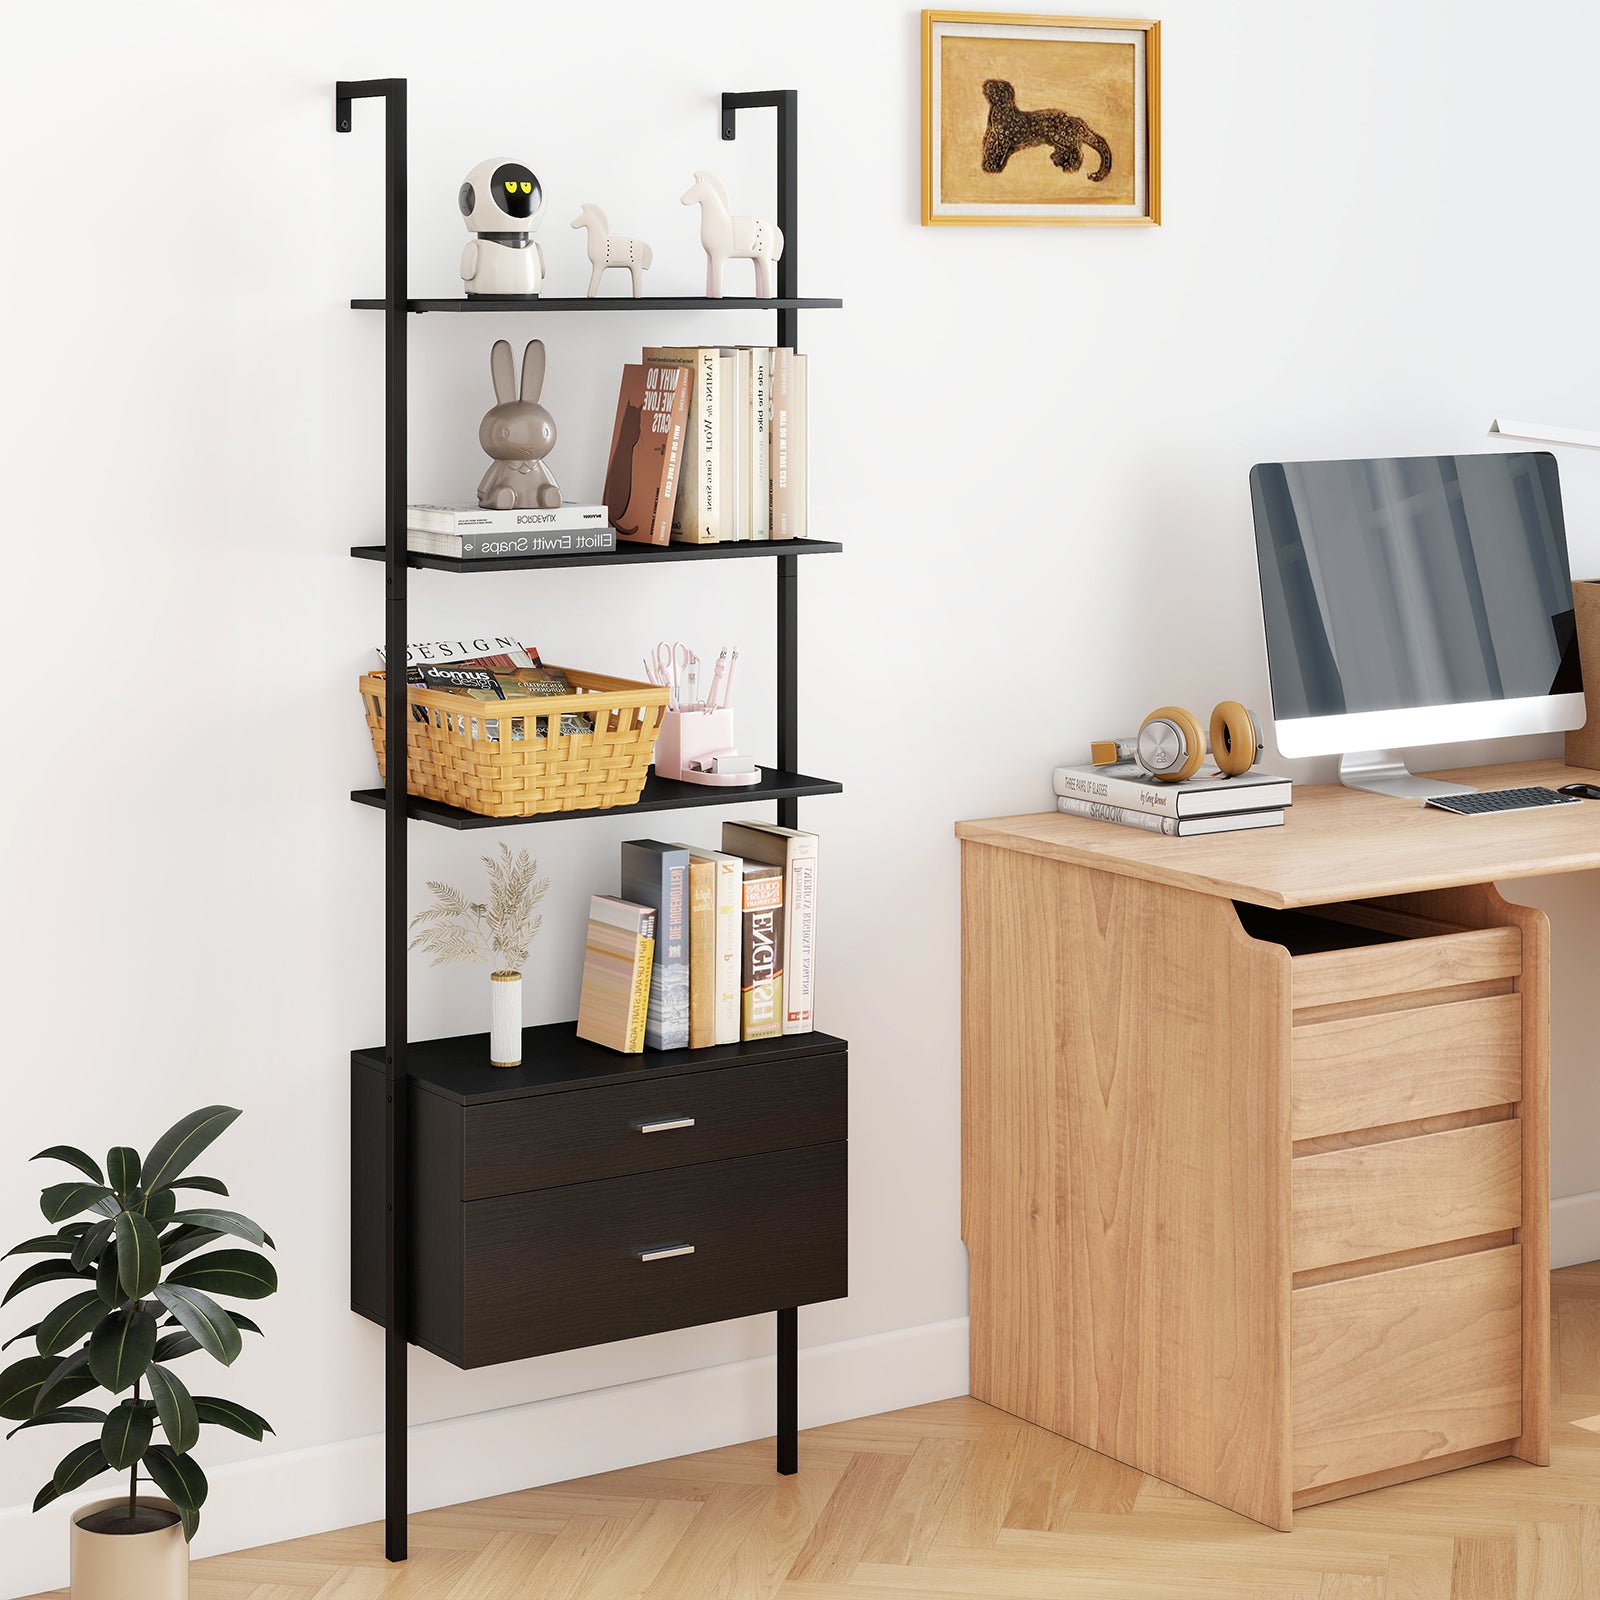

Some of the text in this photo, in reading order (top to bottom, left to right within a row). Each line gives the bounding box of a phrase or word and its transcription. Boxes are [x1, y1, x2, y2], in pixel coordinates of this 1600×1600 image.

[427, 667, 490, 680] domus
[451, 677, 498, 690] design
[1064, 776, 1076, 791] THREE
[1086, 781, 1092, 793] OF
[1092, 782, 1109, 797] GLASSES
[1089, 803, 1123, 823] SHADOW
